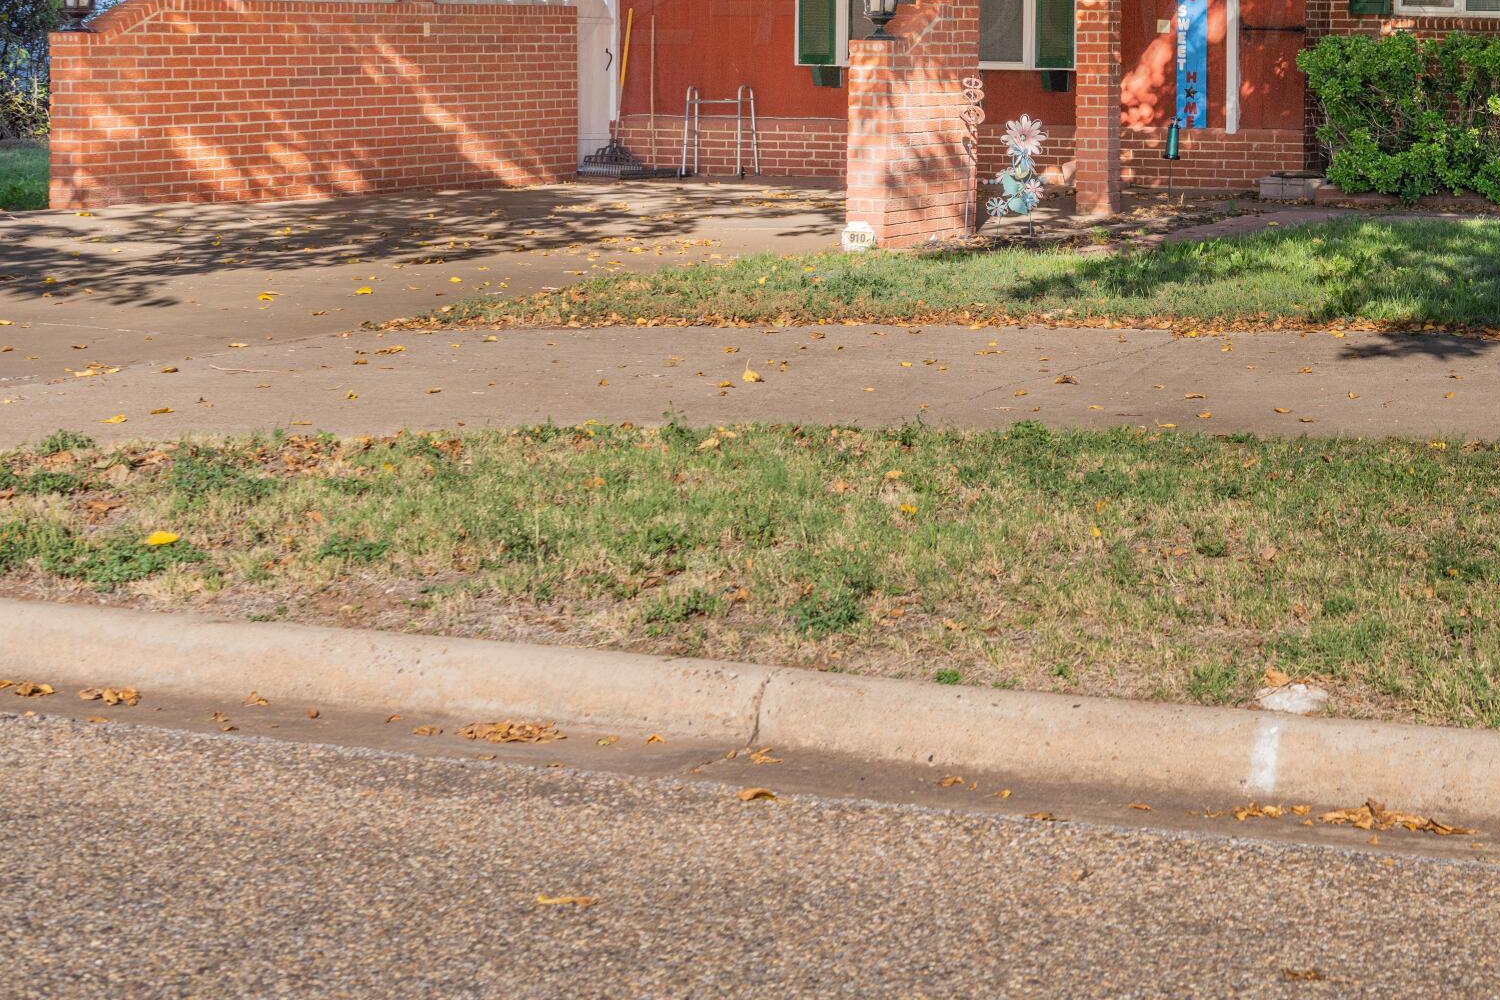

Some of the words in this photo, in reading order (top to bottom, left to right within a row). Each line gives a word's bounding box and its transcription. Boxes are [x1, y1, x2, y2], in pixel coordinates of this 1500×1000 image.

[1177, 4, 1190, 71] SWEET
[1184, 71, 1198, 128] HME
[849, 233, 866, 243] 910
